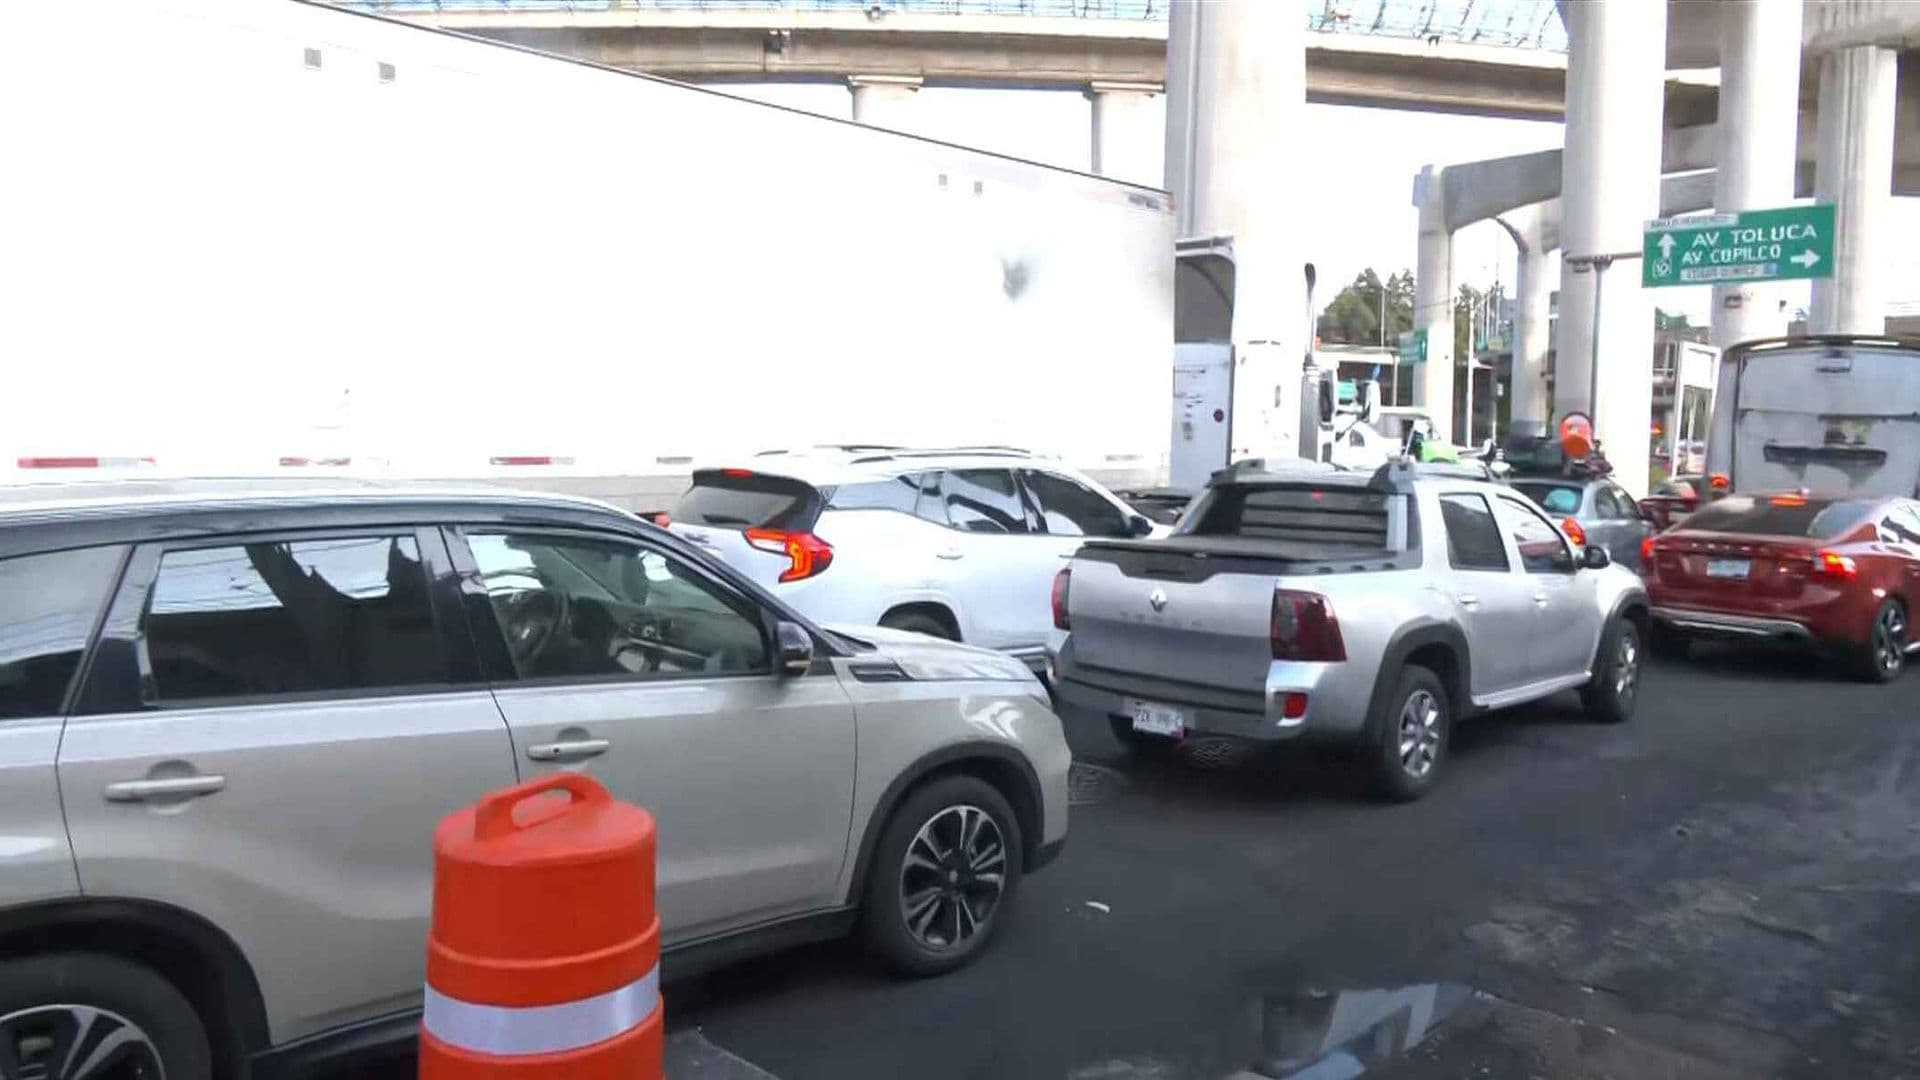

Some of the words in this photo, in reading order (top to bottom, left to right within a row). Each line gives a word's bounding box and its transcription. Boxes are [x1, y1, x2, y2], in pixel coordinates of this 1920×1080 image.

[1692, 231, 1719, 248] AV
[1730, 224, 1817, 244] TOLUCA
[1681, 250, 1702, 265] AV
[1710, 244, 1781, 263] COPILCO
